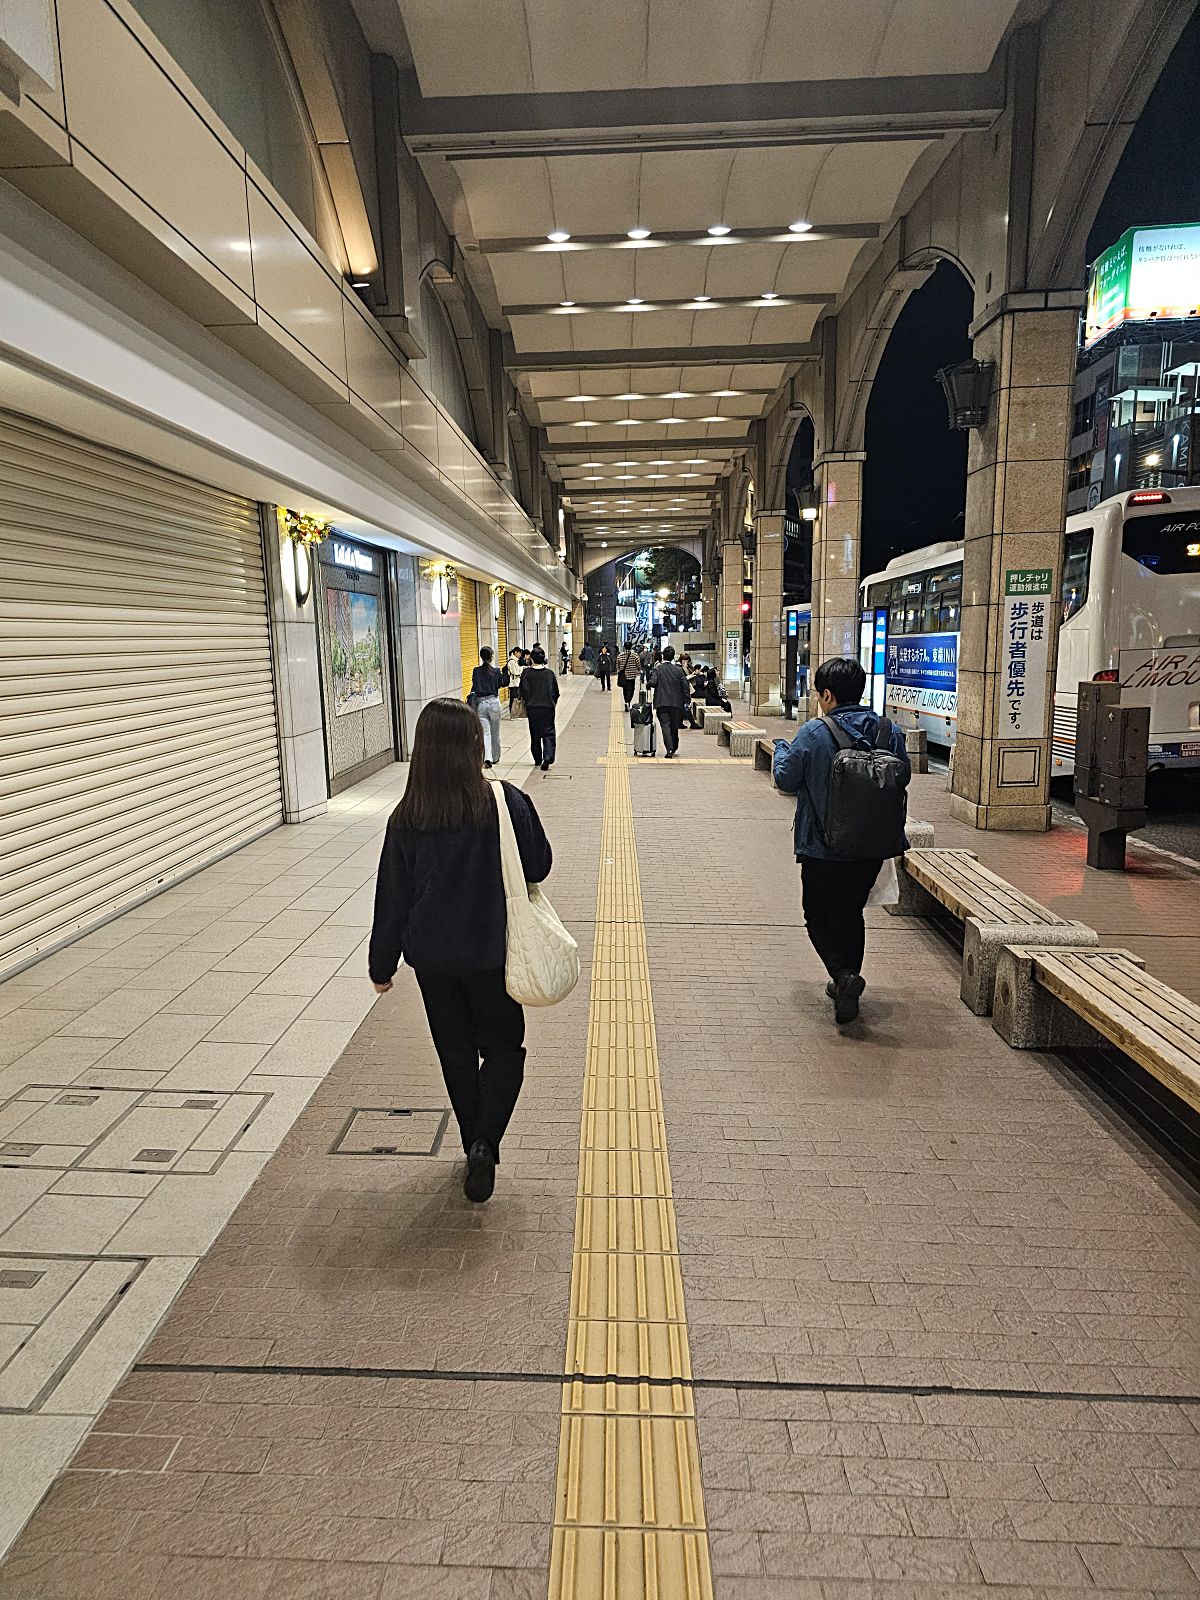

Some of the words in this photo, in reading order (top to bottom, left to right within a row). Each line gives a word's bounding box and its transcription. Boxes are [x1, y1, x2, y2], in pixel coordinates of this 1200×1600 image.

[1160, 523, 1186, 533] AIR
[1009, 573, 1048, 583] 押しチャリ
[1009, 583, 1048, 592] 運動推進中
[1030, 601, 1045, 641] 歩道は
[932, 646, 955, 664] 東横INN
[1135, 655, 1188, 672] AIR
[1007, 601, 1029, 730] 歩行者優先です。
